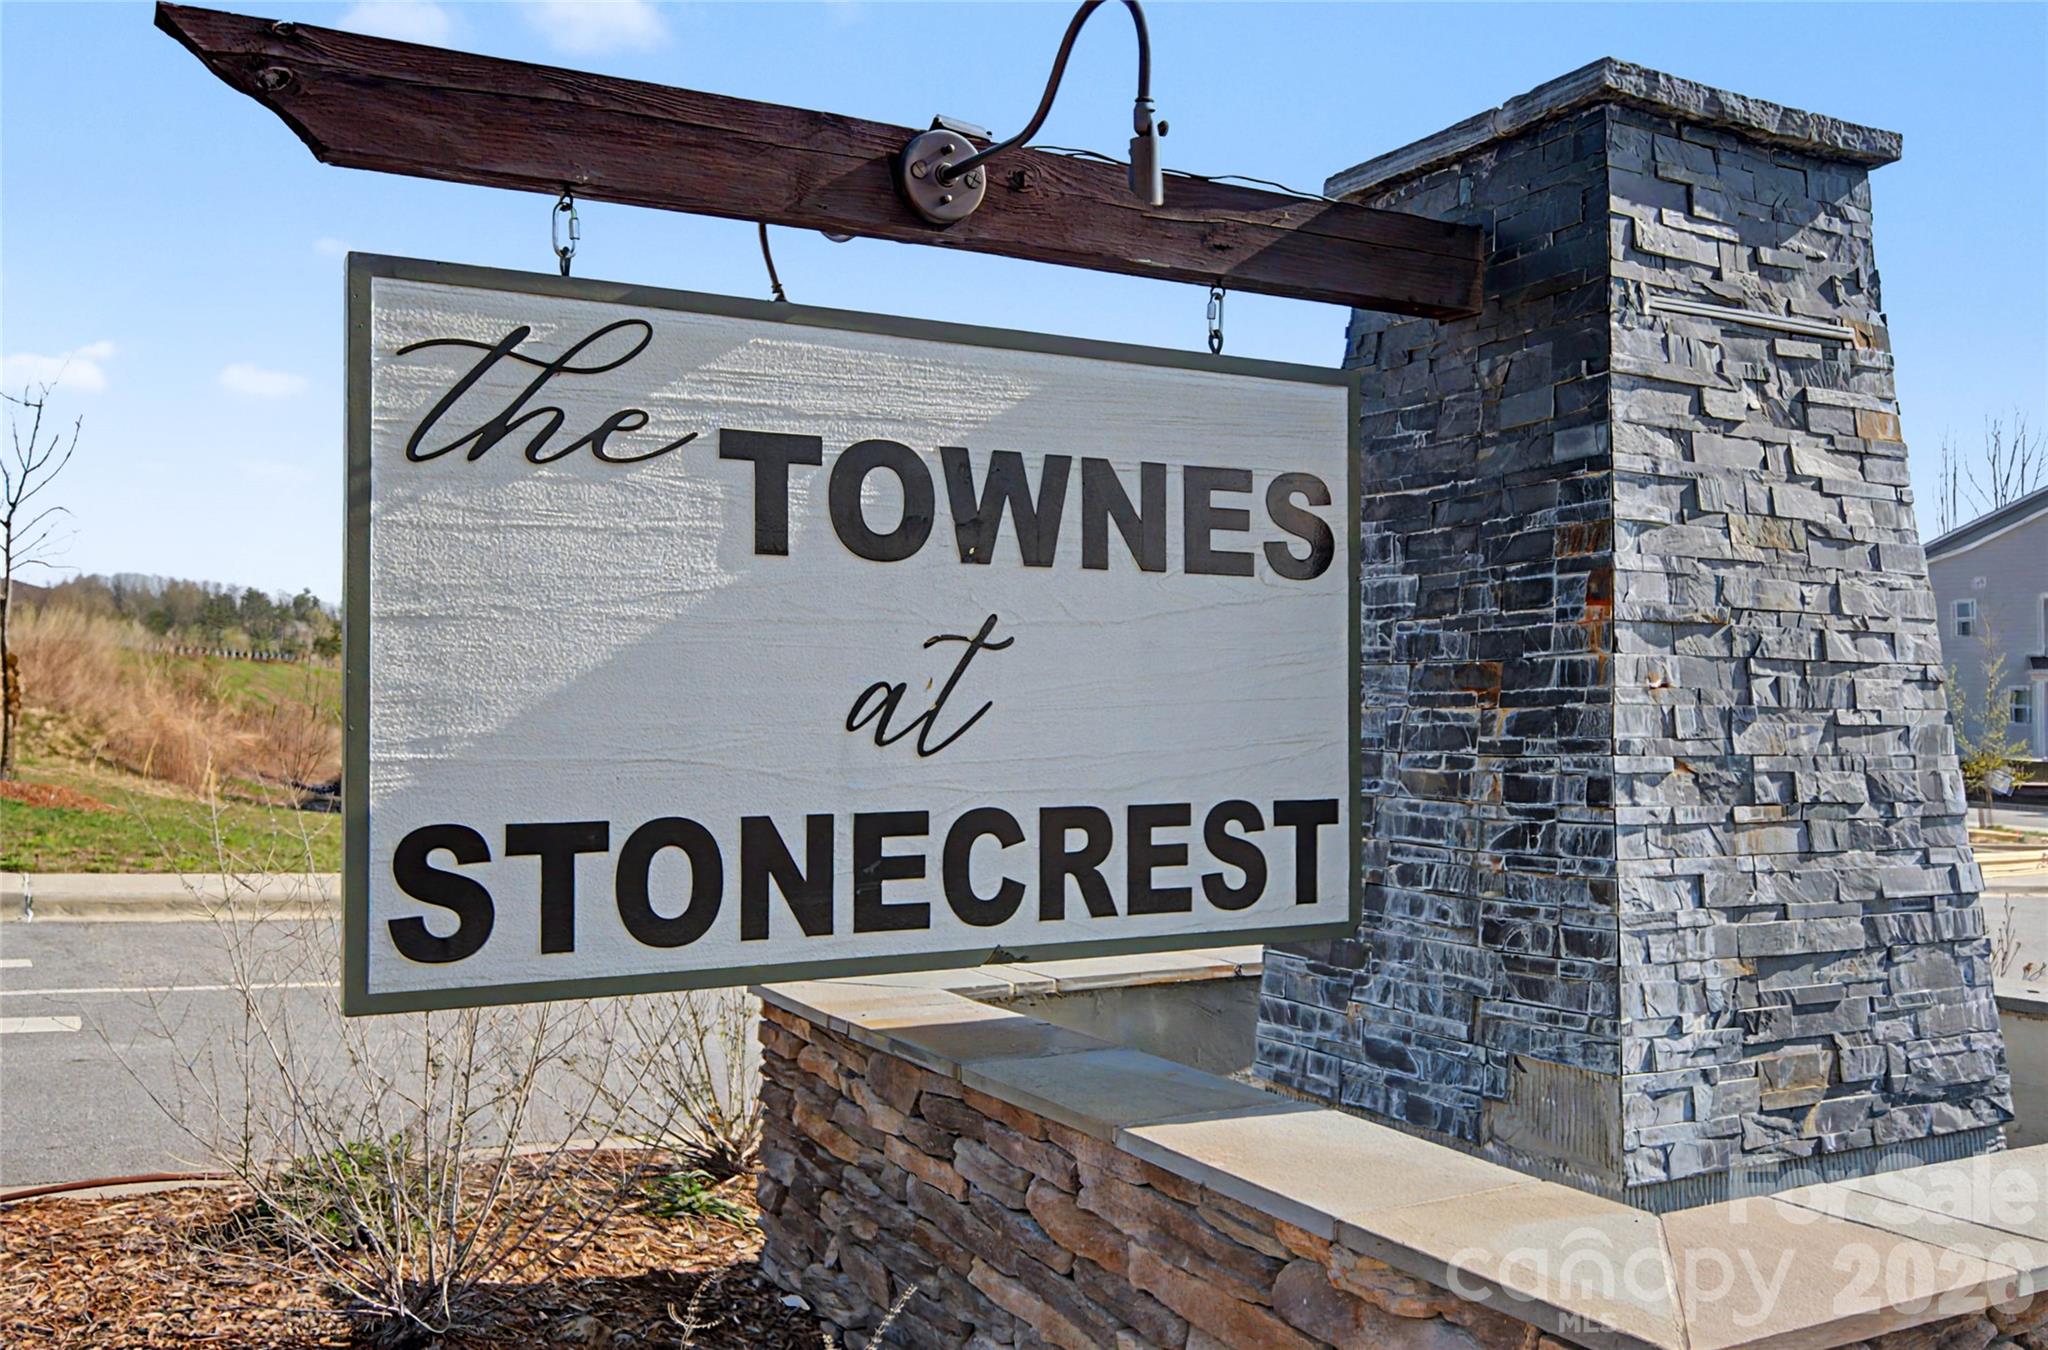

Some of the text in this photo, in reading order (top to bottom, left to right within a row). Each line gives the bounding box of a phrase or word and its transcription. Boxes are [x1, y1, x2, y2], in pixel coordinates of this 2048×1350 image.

[396, 319, 1334, 580] the TOWNES
[846, 614, 1014, 757] at
[388, 799, 1339, 963] STONECREST
